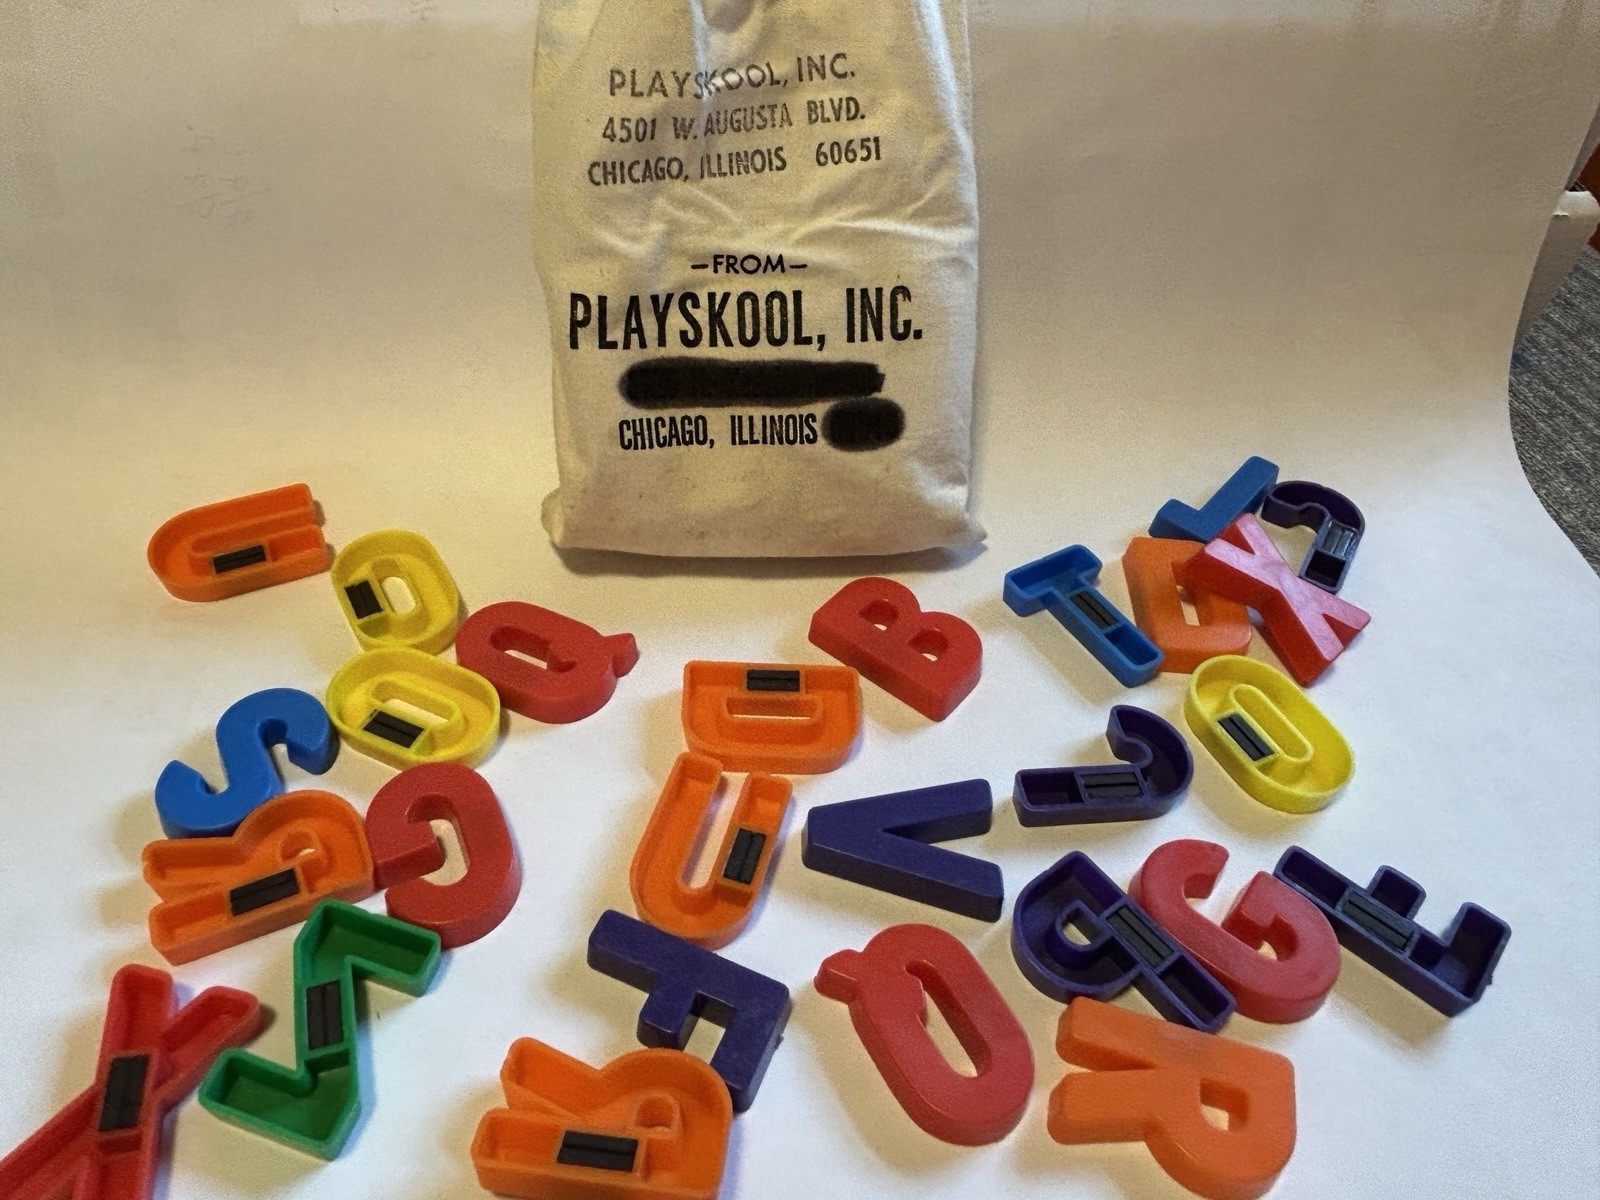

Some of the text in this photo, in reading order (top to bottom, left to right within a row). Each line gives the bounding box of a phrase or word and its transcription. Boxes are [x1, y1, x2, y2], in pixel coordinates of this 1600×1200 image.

[601, 96, 866, 144] 4501 W. AUGUSTA BLVD.
[608, 52, 856, 100] PLAYSKOOL, INC.
[587, 136, 882, 187] CHICAGO, ILLINOIS 60651
[569, 285, 923, 351] PLAYSKOOL, INC.
[618, 414, 715, 451] CHICAGO,
[729, 412, 818, 446] ILLINOIS
[1003, 544, 1165, 688] T
[1176, 512, 1372, 688] X
[455, 600, 639, 724] Q
[808, 576, 983, 722] B
[154, 686, 339, 838] S
